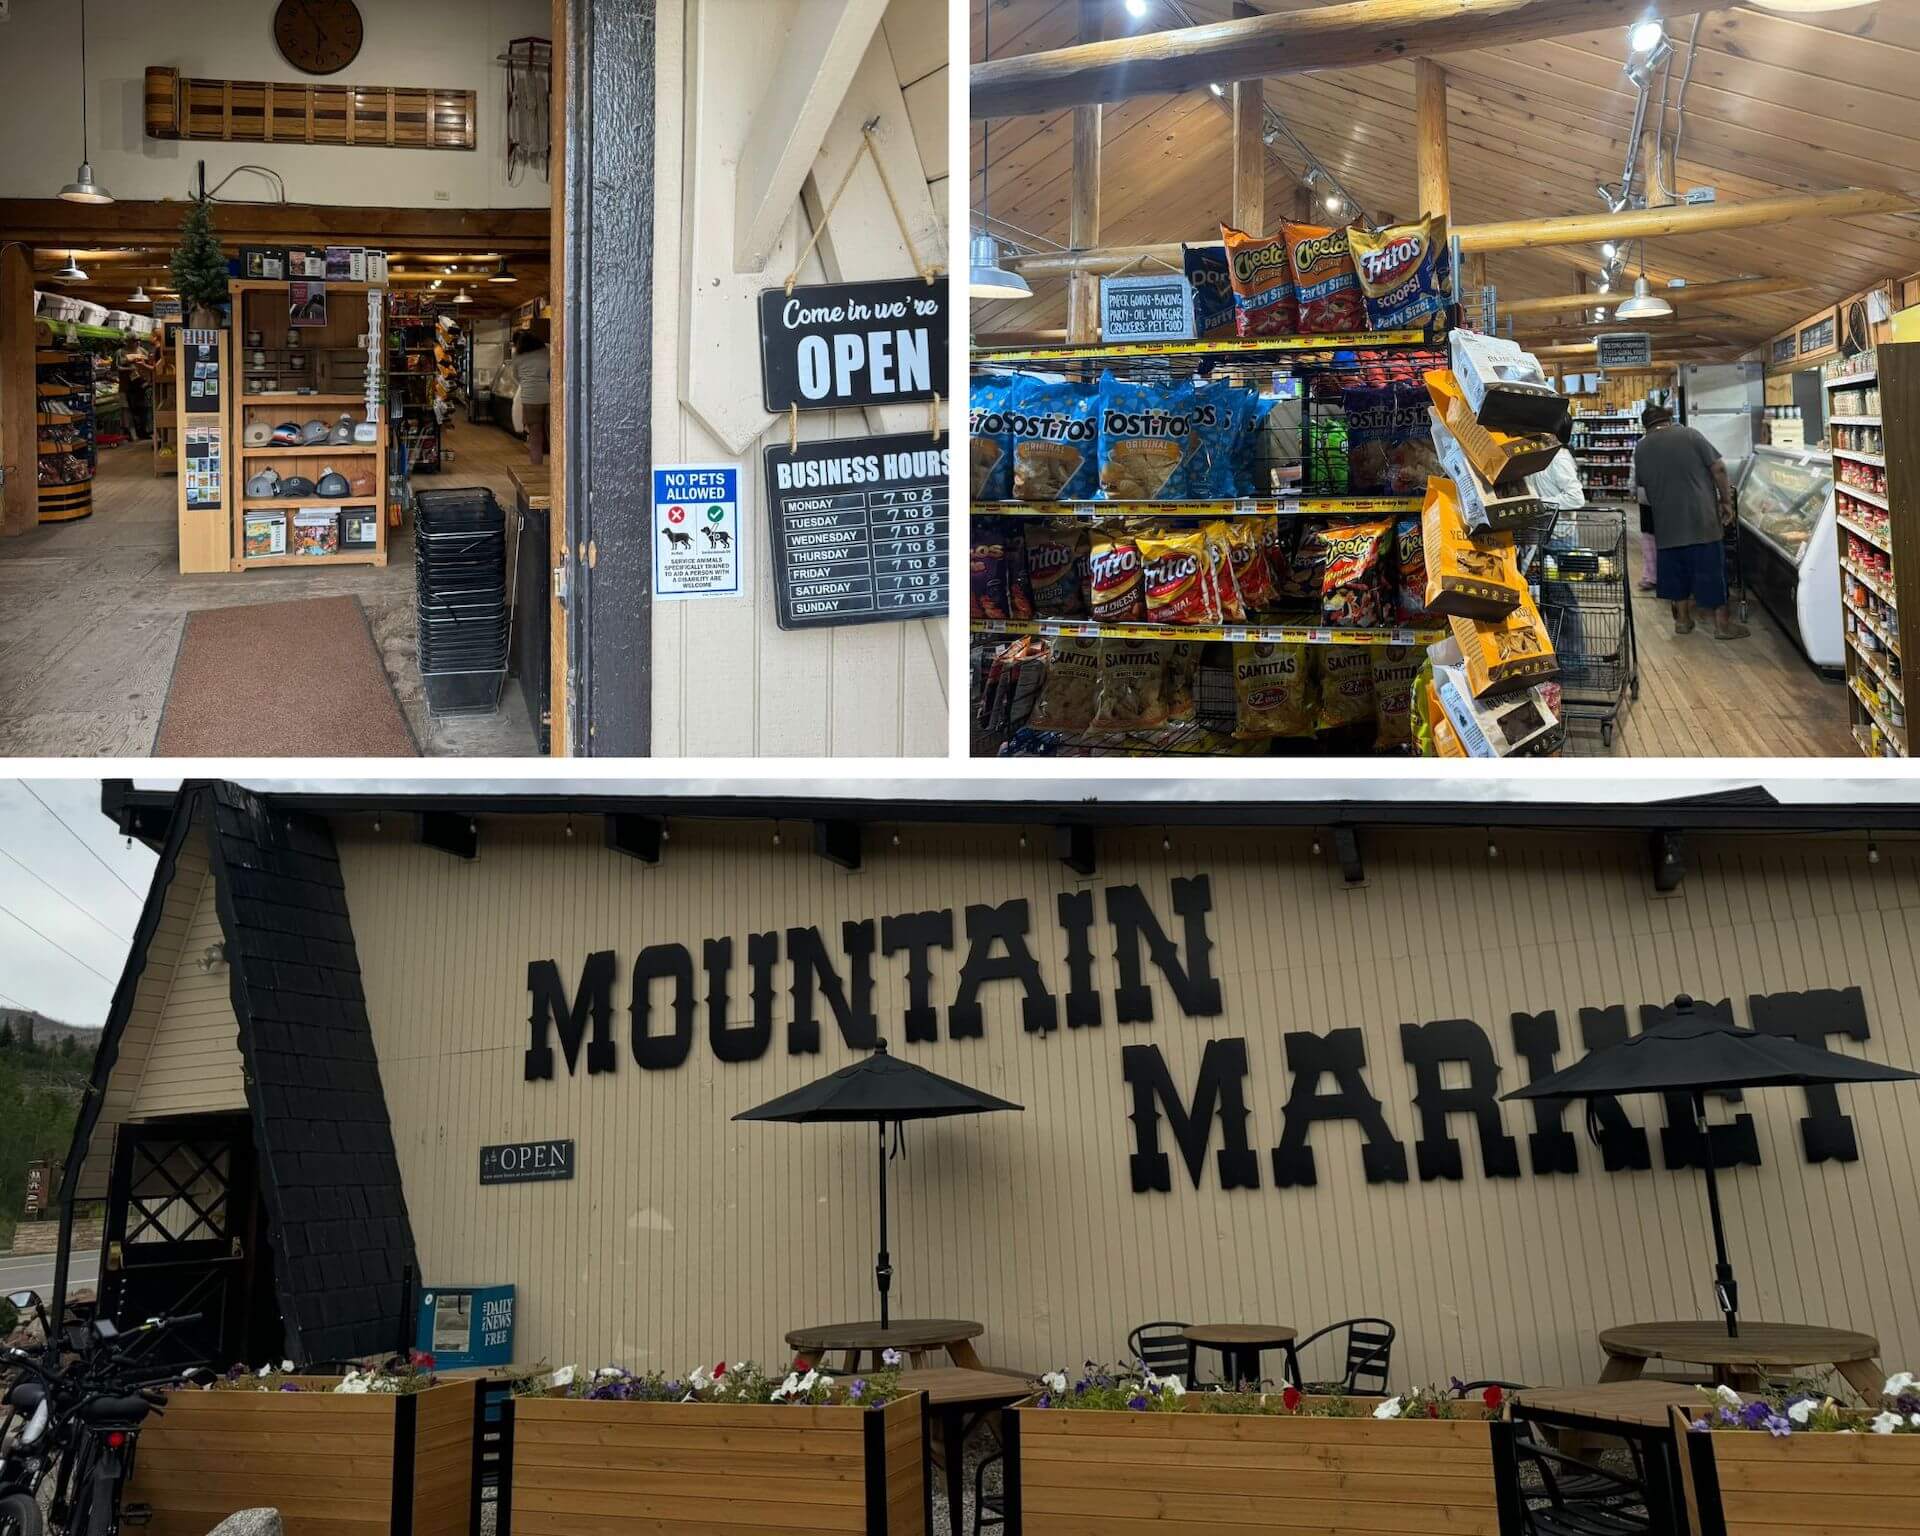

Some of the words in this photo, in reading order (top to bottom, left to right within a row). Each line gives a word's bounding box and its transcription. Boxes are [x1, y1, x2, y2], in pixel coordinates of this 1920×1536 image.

[1361, 238, 1420, 282] Fritos
[1110, 294, 1129, 308] PAPER
[1130, 294, 1150, 307] GOODS
[1154, 293, 1182, 306] BAKING
[1377, 276, 1421, 308] SCOOPS!
[782, 299, 845, 329] Come
[848, 299, 871, 321] in
[875, 295, 938, 318] we're
[1110, 309, 1128, 321] PARTY
[1134, 309, 1147, 320] OIL
[1151, 308, 1182, 320] VINEGAR
[1377, 311, 1403, 329] Party
[1405, 300, 1430, 318] Size!
[1110, 320, 1145, 333] CRACKERS
[1148, 320, 1162, 332] PET
[1164, 320, 1182, 331] FOOD
[797, 328, 931, 400] OPEN
[1014, 413, 1097, 441] OSTITOS
[1103, 410, 1191, 437] TOSTITOS
[1126, 440, 1168, 450] ORIGINAL
[665, 474, 685, 486] NO
[689, 473, 725, 485] PETS
[777, 455, 880, 489] BUSINESS
[884, 449, 950, 481] HOURS
[666, 487, 725, 500] ALLOWED
[788, 499, 833, 512] MONDAY
[883, 492, 895, 505] 7
[902, 491, 916, 502] TO
[921, 488, 933, 502] 8
[790, 515, 839, 528] TUESDAY
[887, 508, 899, 522] 7
[904, 508, 918, 518] TO
[922, 505, 933, 518] 8
[791, 531, 857, 545] WEDNESDAY
[890, 525, 901, 539] 7
[905, 525, 919, 535] TO
[924, 522, 935, 535] 8
[793, 548, 849, 563] THURSDAY
[891, 543, 902, 555] 7
[907, 542, 921, 552] TO
[926, 539, 936, 552] 8
[793, 567, 831, 579] FRIDAY
[891, 559, 902, 571] 7
[908, 559, 922, 569] TO
[927, 556, 936, 568] 8
[1091, 551, 1137, 585] Frito
[795, 583, 851, 596] SATURDAY
[893, 577, 902, 589] 7
[909, 576, 923, 586] TO
[929, 573, 939, 585] 8
[796, 601, 839, 614] SUNDAY
[894, 594, 904, 604] 7
[910, 593, 925, 603] TO
[929, 589, 938, 601] 8
[1052, 651, 1098, 668] SANTITA
[1105, 651, 1160, 668] SANTITAS
[1238, 658, 1295, 680] SANTITAS
[525, 873, 1222, 1082] MOUNTAIN
[501, 1143, 567, 1170] OPEN
[486, 1298, 513, 1315] DAILY
[486, 1313, 512, 1330] NEWS
[484, 1330, 507, 1346] FREE
